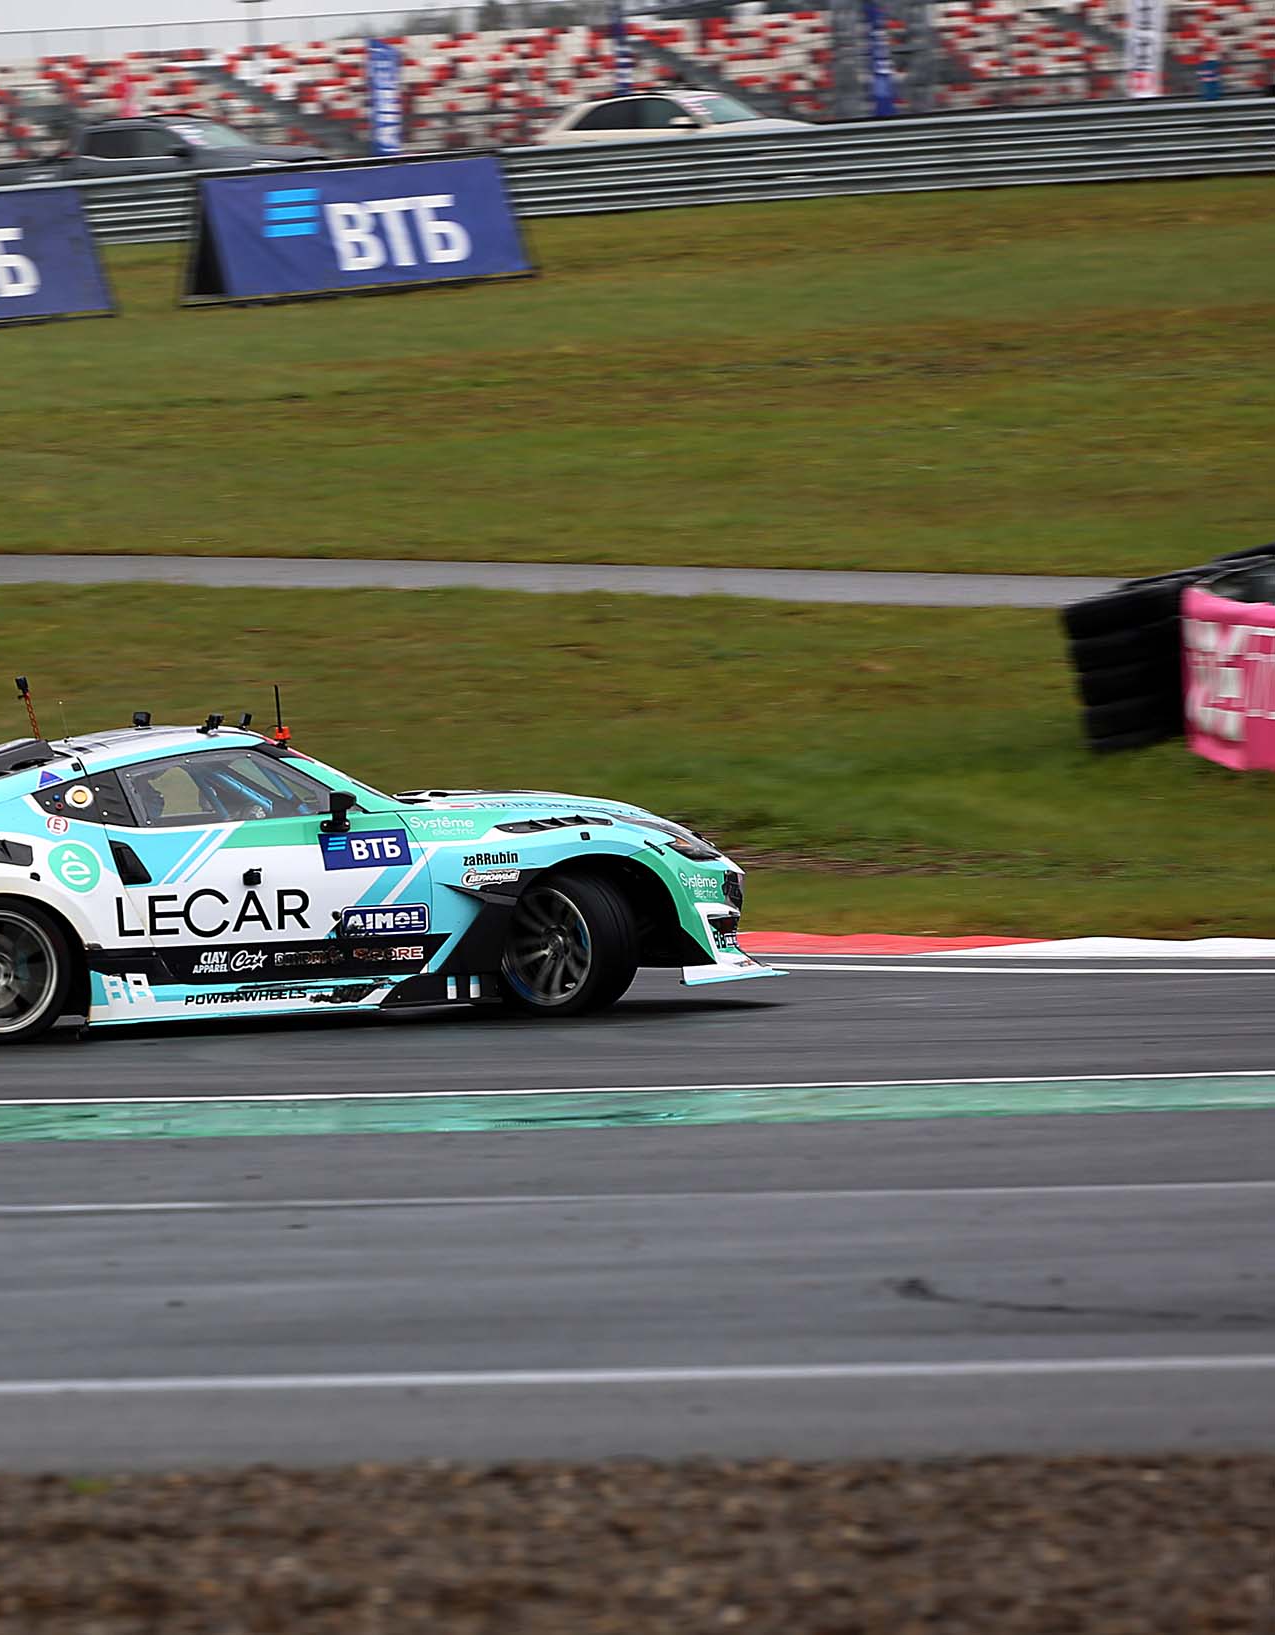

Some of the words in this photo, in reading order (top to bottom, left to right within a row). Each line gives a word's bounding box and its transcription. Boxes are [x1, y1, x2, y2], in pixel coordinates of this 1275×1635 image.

[326, 194, 472, 272] ВТБ
[350, 836, 402, 861] ВТБ
[462, 851, 519, 867] zaRRubin
[115, 888, 311, 938] LECAR
[347, 911, 425, 930] AIMOL
[192, 963, 229, 974] APPAREL
[101, 973, 156, 1007] 88
